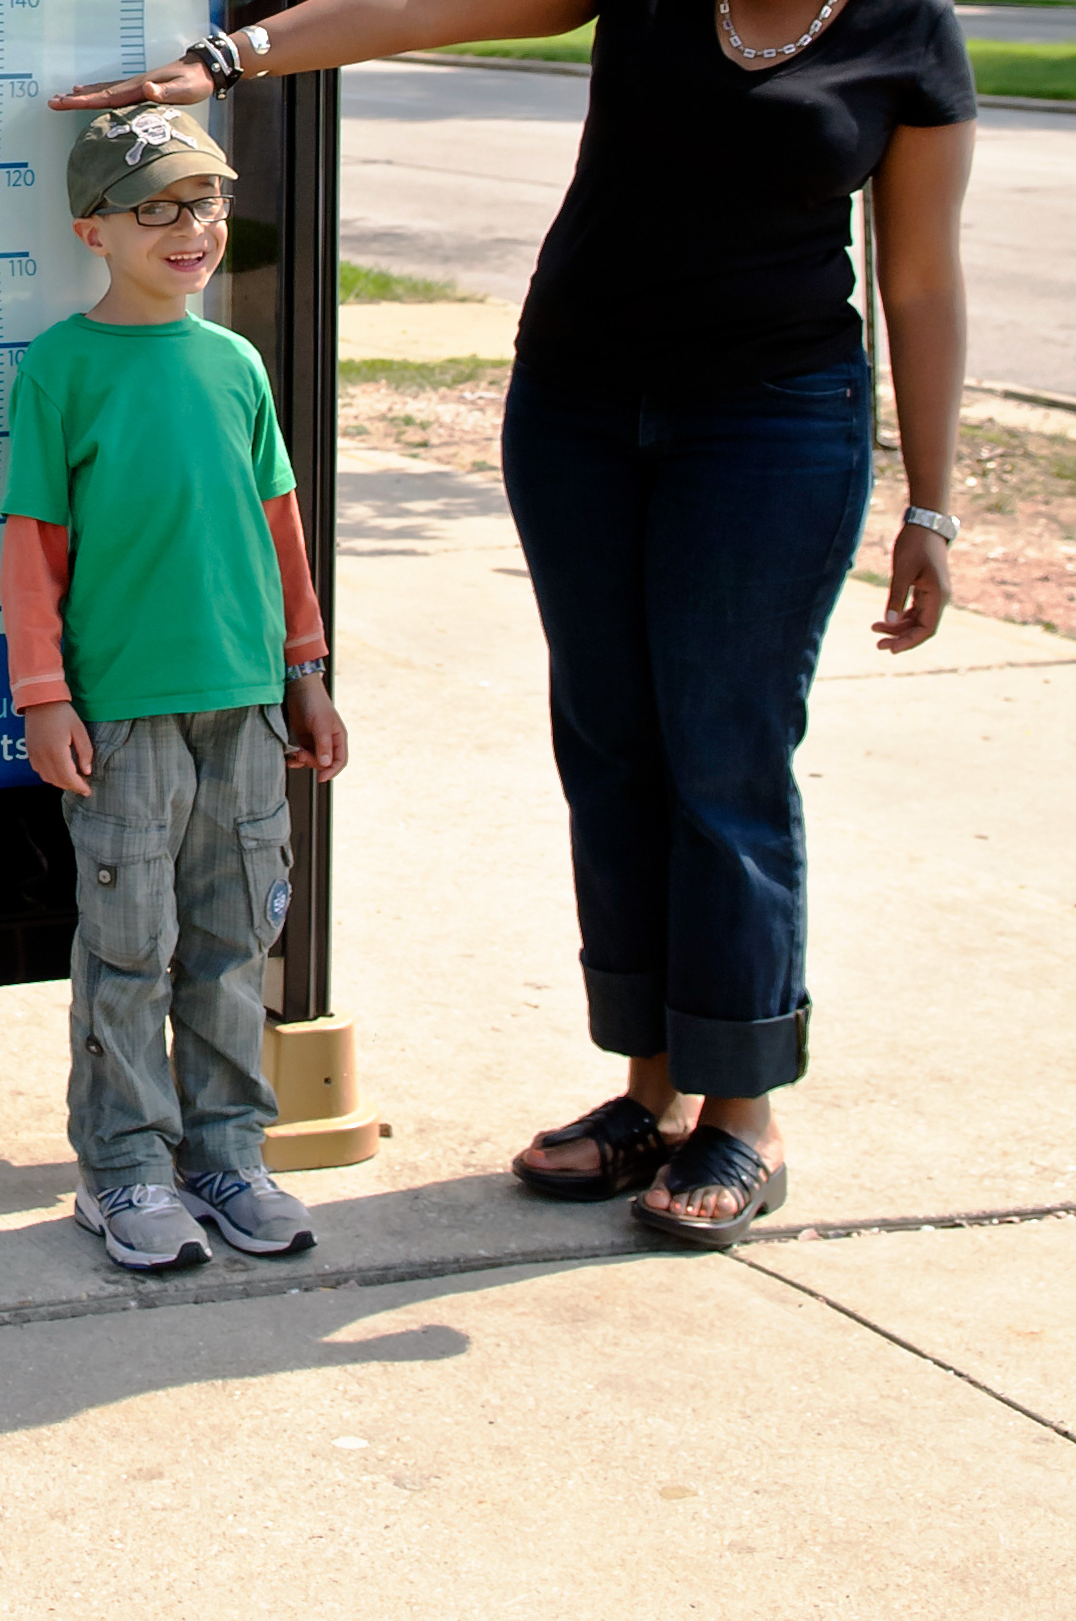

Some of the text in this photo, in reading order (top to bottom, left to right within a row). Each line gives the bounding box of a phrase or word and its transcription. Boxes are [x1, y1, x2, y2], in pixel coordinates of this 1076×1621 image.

[9, 81, 39, 98] 130
[5, 170, 35, 187] 120
[9, 259, 37, 276] 110
